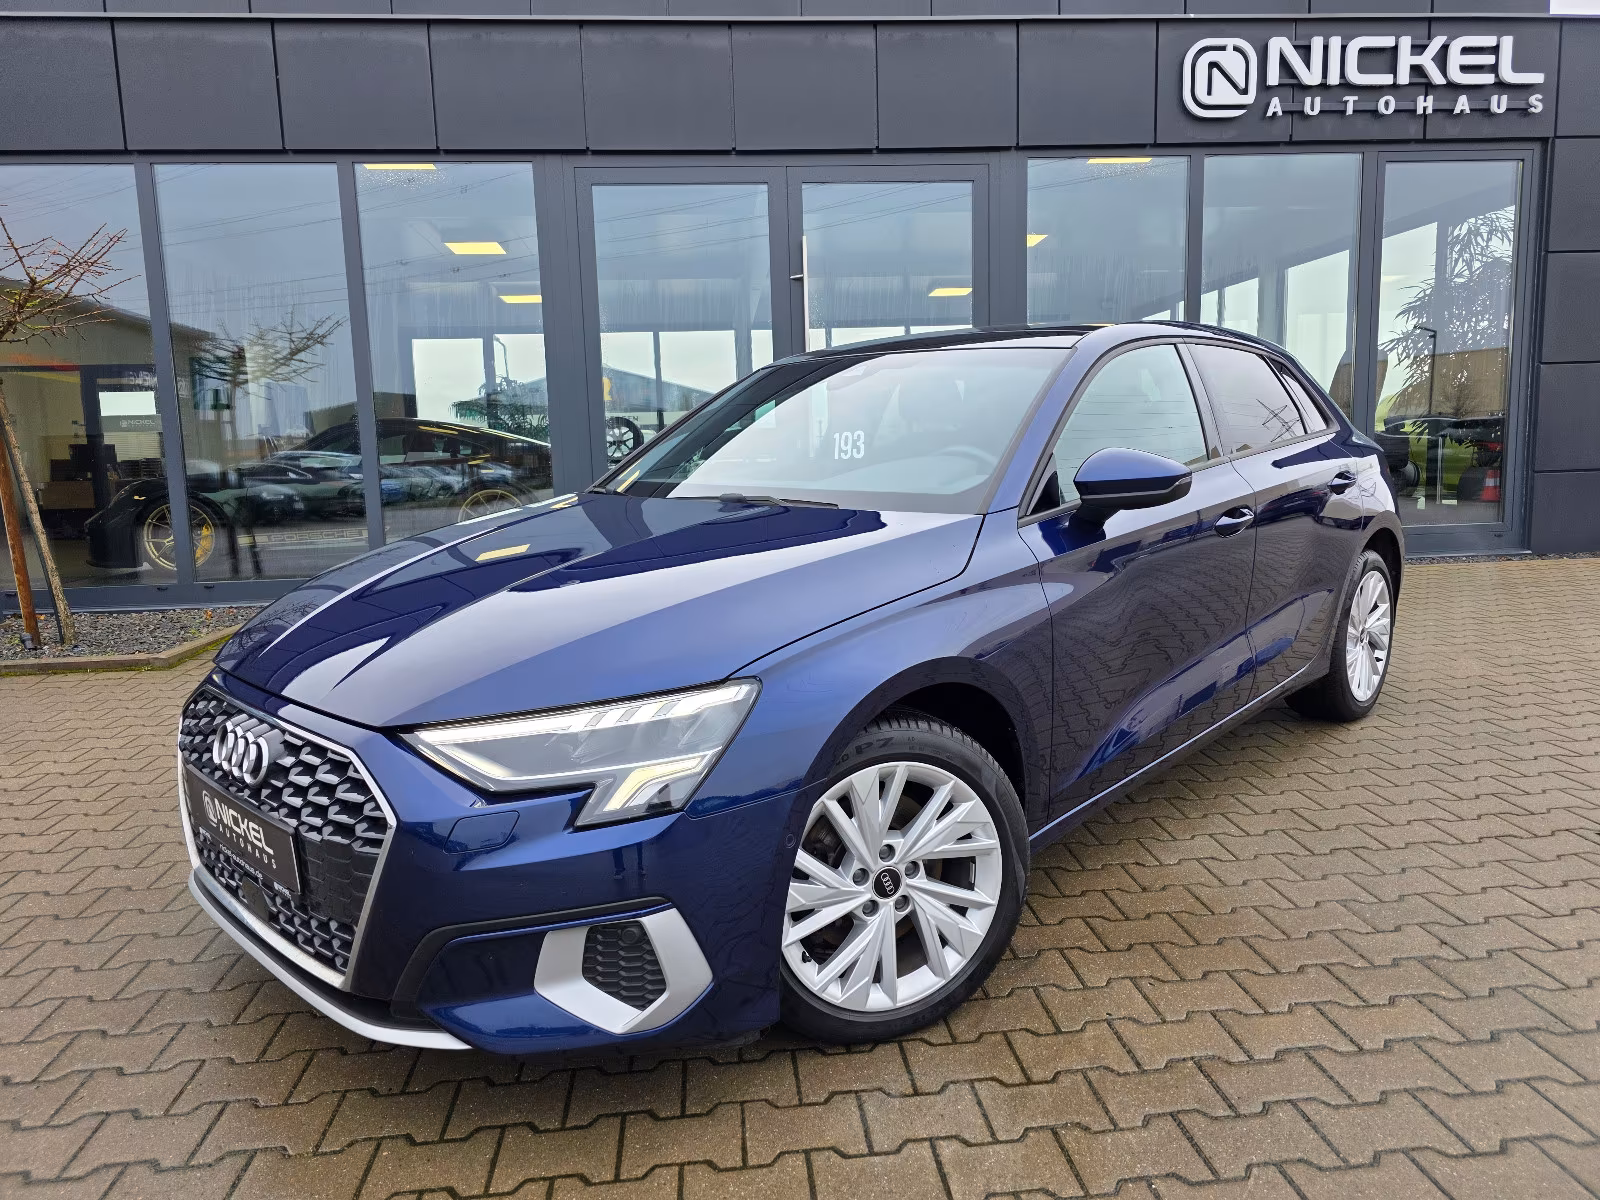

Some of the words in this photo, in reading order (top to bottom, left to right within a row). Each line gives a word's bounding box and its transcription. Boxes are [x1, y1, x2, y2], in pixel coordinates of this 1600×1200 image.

[1266, 35, 1545, 86] NICKEL
[1266, 93, 1543, 117] AUTOHAUS
[833, 429, 865, 460] 193
[271, 529, 360, 541] PORSCHE
[214, 797, 274, 856] NICKEL
[219, 823, 277, 869] AUTOHAUS
